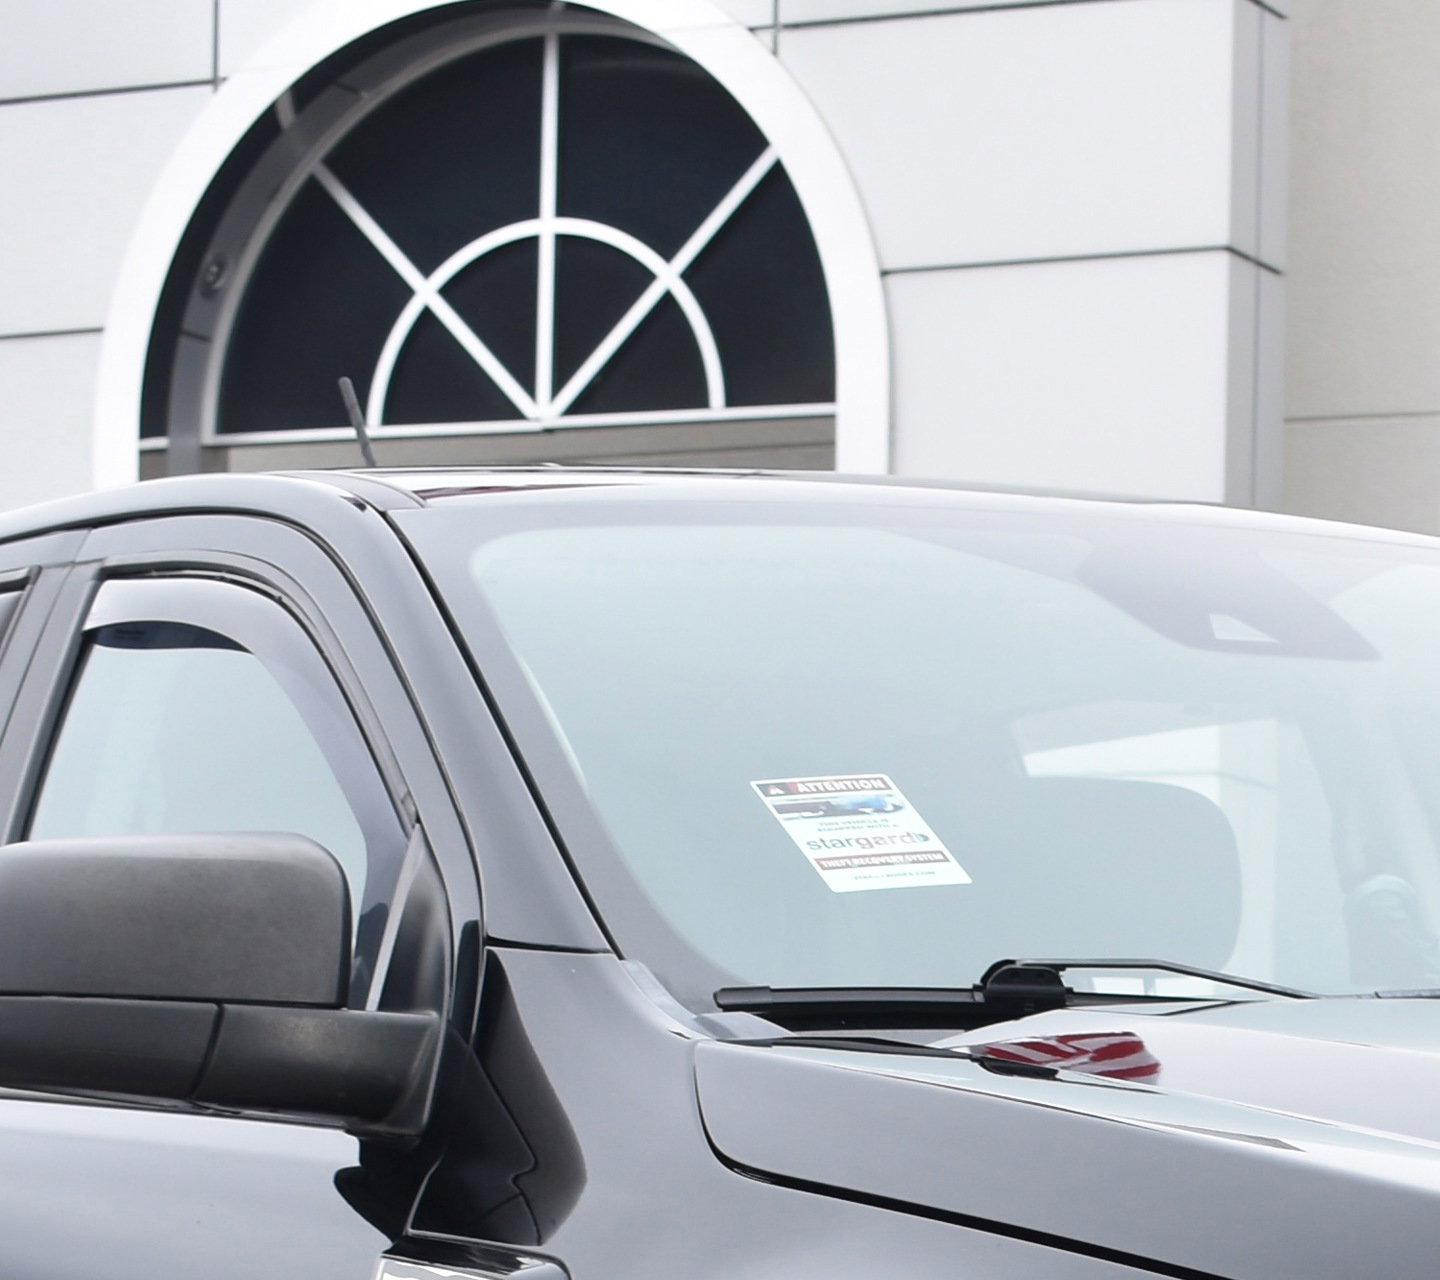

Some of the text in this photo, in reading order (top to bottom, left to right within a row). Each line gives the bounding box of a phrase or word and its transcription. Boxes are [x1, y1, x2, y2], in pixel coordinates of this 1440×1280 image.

[797, 777, 886, 793] ATTENTION
[806, 831, 917, 851] stargard
[821, 858, 852, 868] THEFT
[904, 852, 945, 863] SYSTEM
